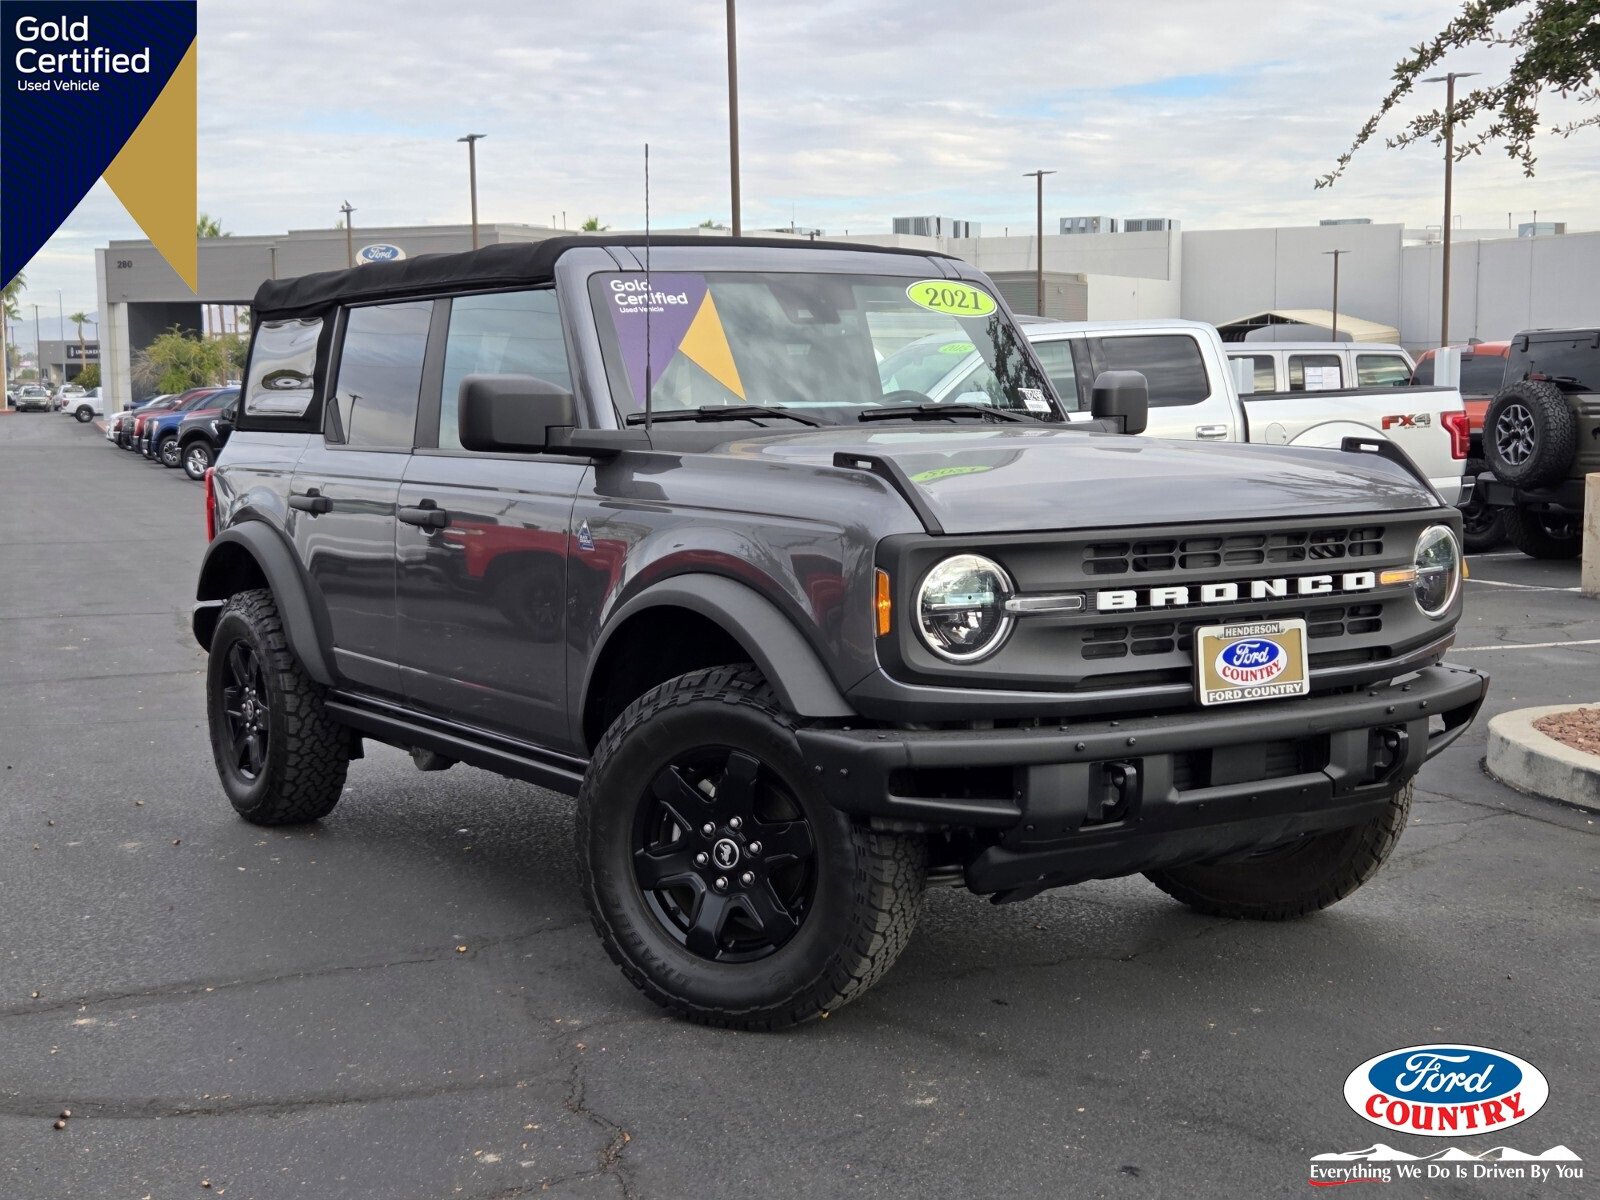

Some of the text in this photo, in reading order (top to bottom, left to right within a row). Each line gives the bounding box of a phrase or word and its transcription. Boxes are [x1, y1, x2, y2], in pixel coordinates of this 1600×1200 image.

[117, 260, 133, 269] 280
[610, 279, 652, 292] Gold
[614, 292, 688, 305] Certified
[925, 287, 983, 311] 2021
[1381, 413, 1431, 430] FX4
[1096, 571, 1376, 611] BRONCO
[1224, 624, 1279, 637] HENDERSON
[1233, 643, 1270, 666] Ford
[1222, 660, 1282, 682] COUNTRY
[1208, 683, 1303, 702] FORD COUNTRY
